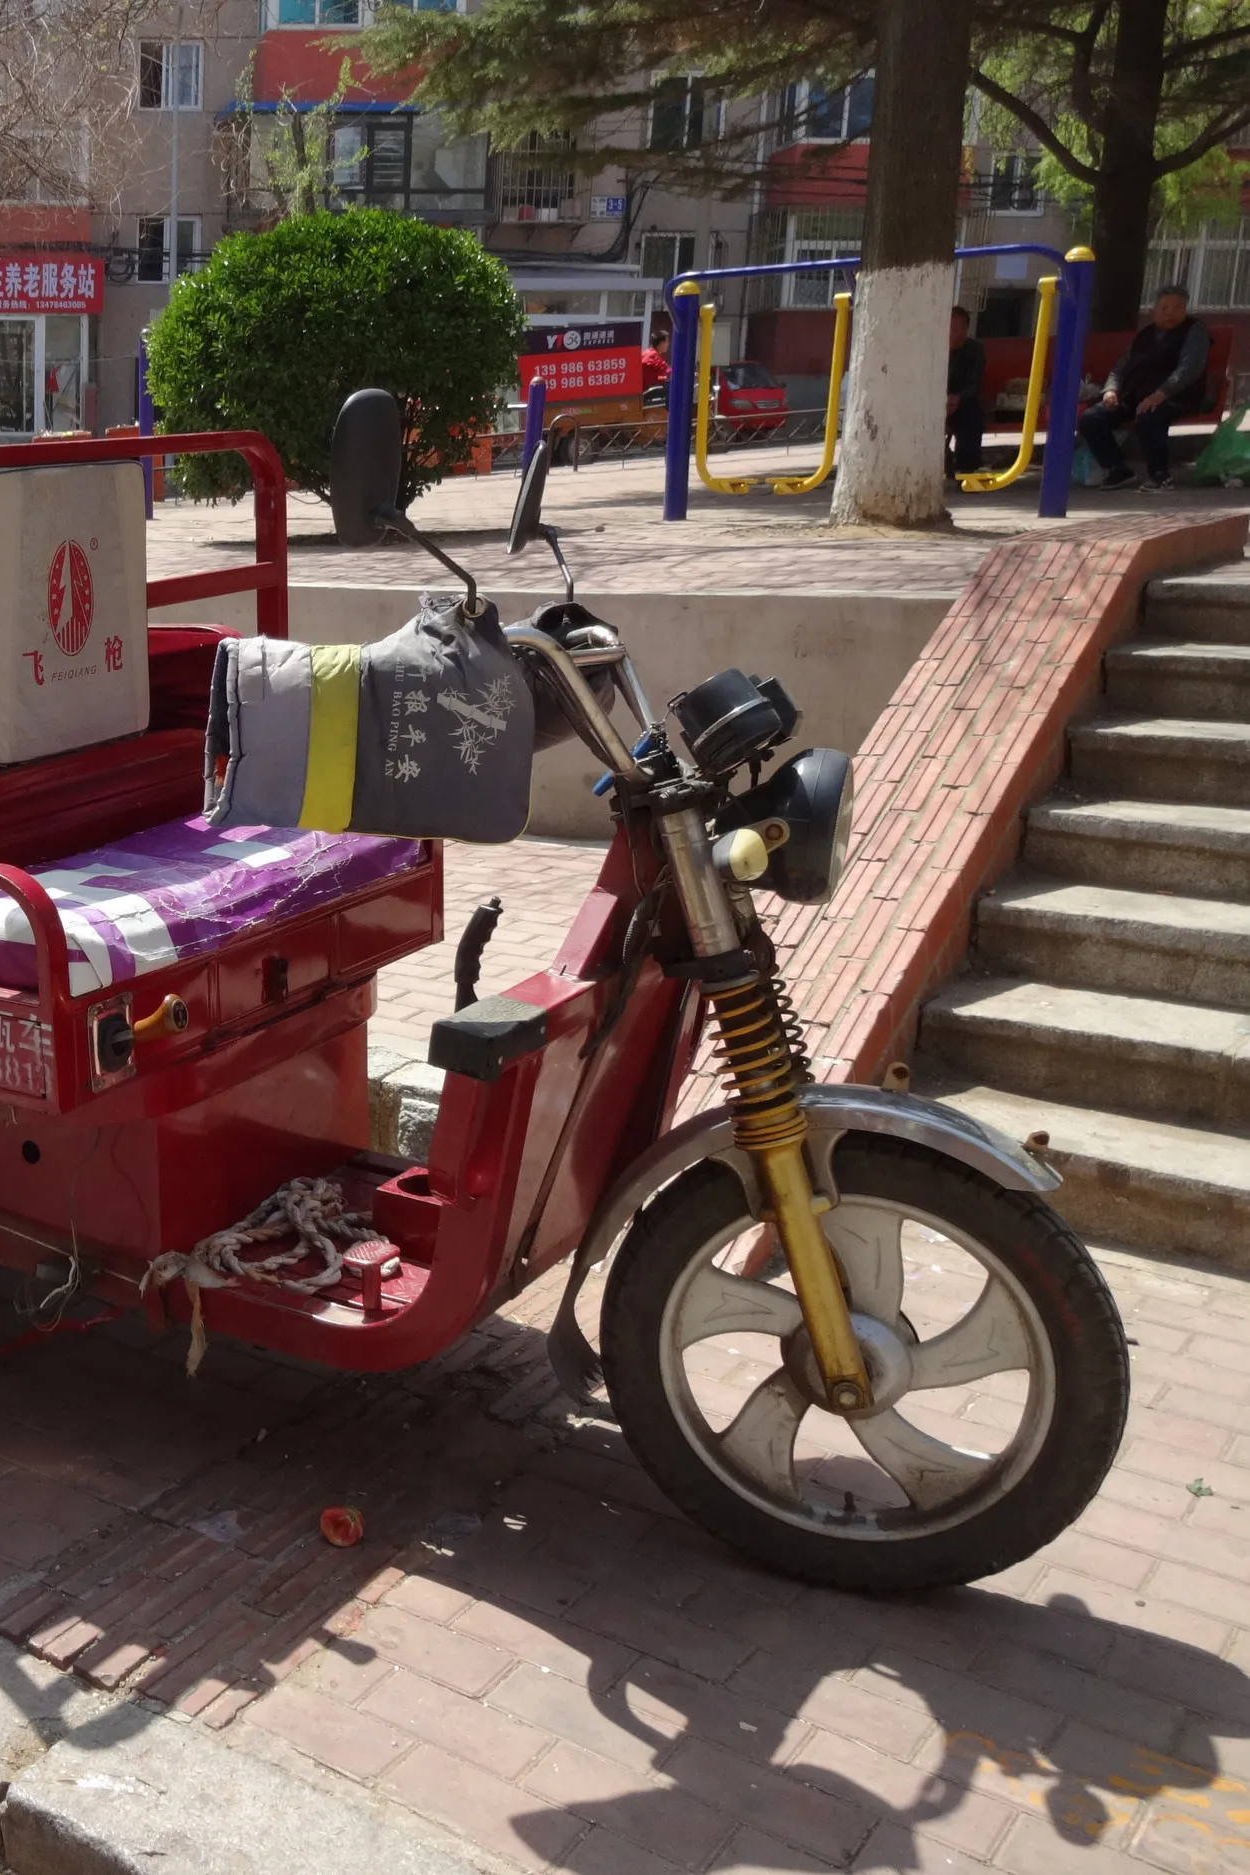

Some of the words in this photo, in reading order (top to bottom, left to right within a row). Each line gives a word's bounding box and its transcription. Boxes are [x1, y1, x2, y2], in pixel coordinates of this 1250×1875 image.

[534, 363, 556, 377] 139
[561, 361, 584, 374] 986
[588, 357, 626, 372] 63859
[561, 376, 584, 389] 986
[588, 372, 626, 386] 63867
[22, 650, 45, 686] 飞
[104, 635, 124, 672] 枪
[51, 665, 97, 682] FEIQIANG
[391, 691, 403, 717] BAO
[387, 721, 400, 752] PING
[384, 759, 395, 776] AN
